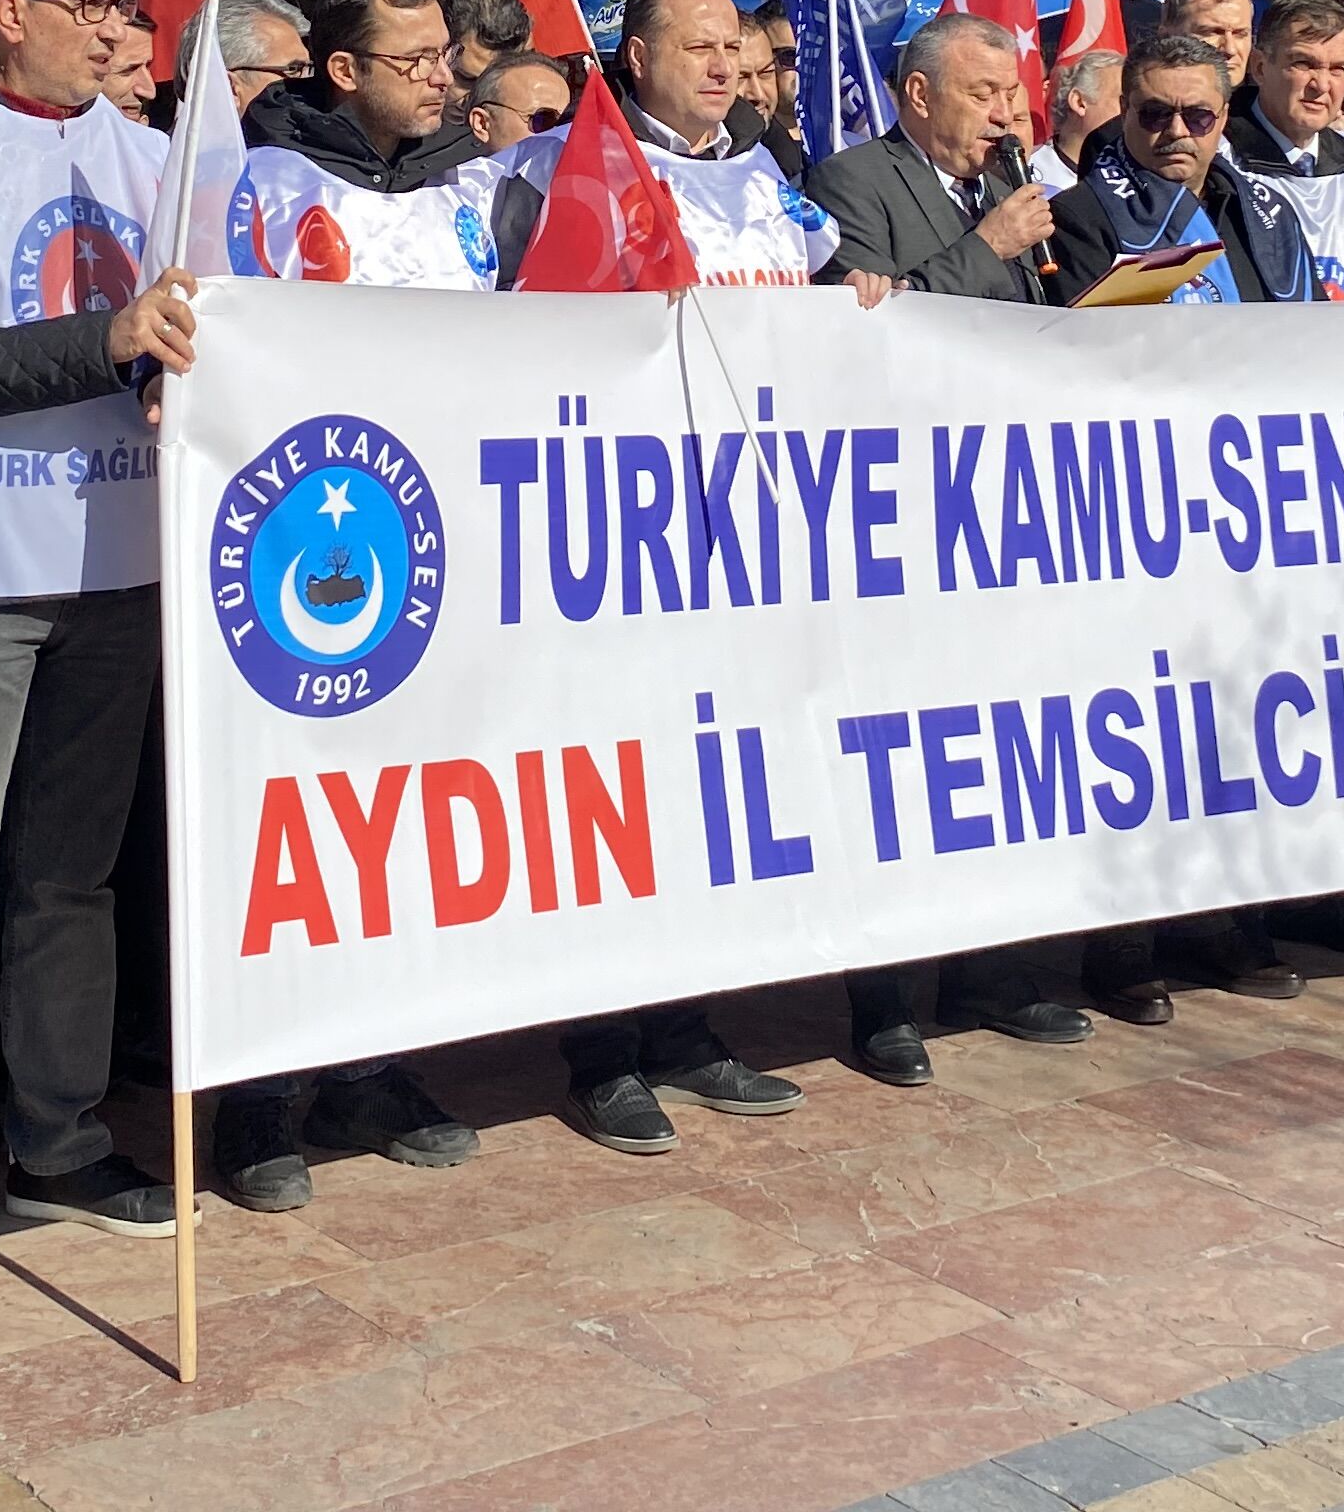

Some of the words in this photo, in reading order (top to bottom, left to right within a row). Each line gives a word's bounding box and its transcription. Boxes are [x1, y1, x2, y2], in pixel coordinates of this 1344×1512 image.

[17, 243, 41, 321] ÜRK
[219, 443, 305, 647] TÜRKİYE
[325, 426, 438, 630] KAMU-SEN
[480, 386, 905, 626] TÜRKİYE
[295, 667, 372, 705] 1992
[240, 739, 658, 958] AYDIN
[694, 691, 815, 888] İL
